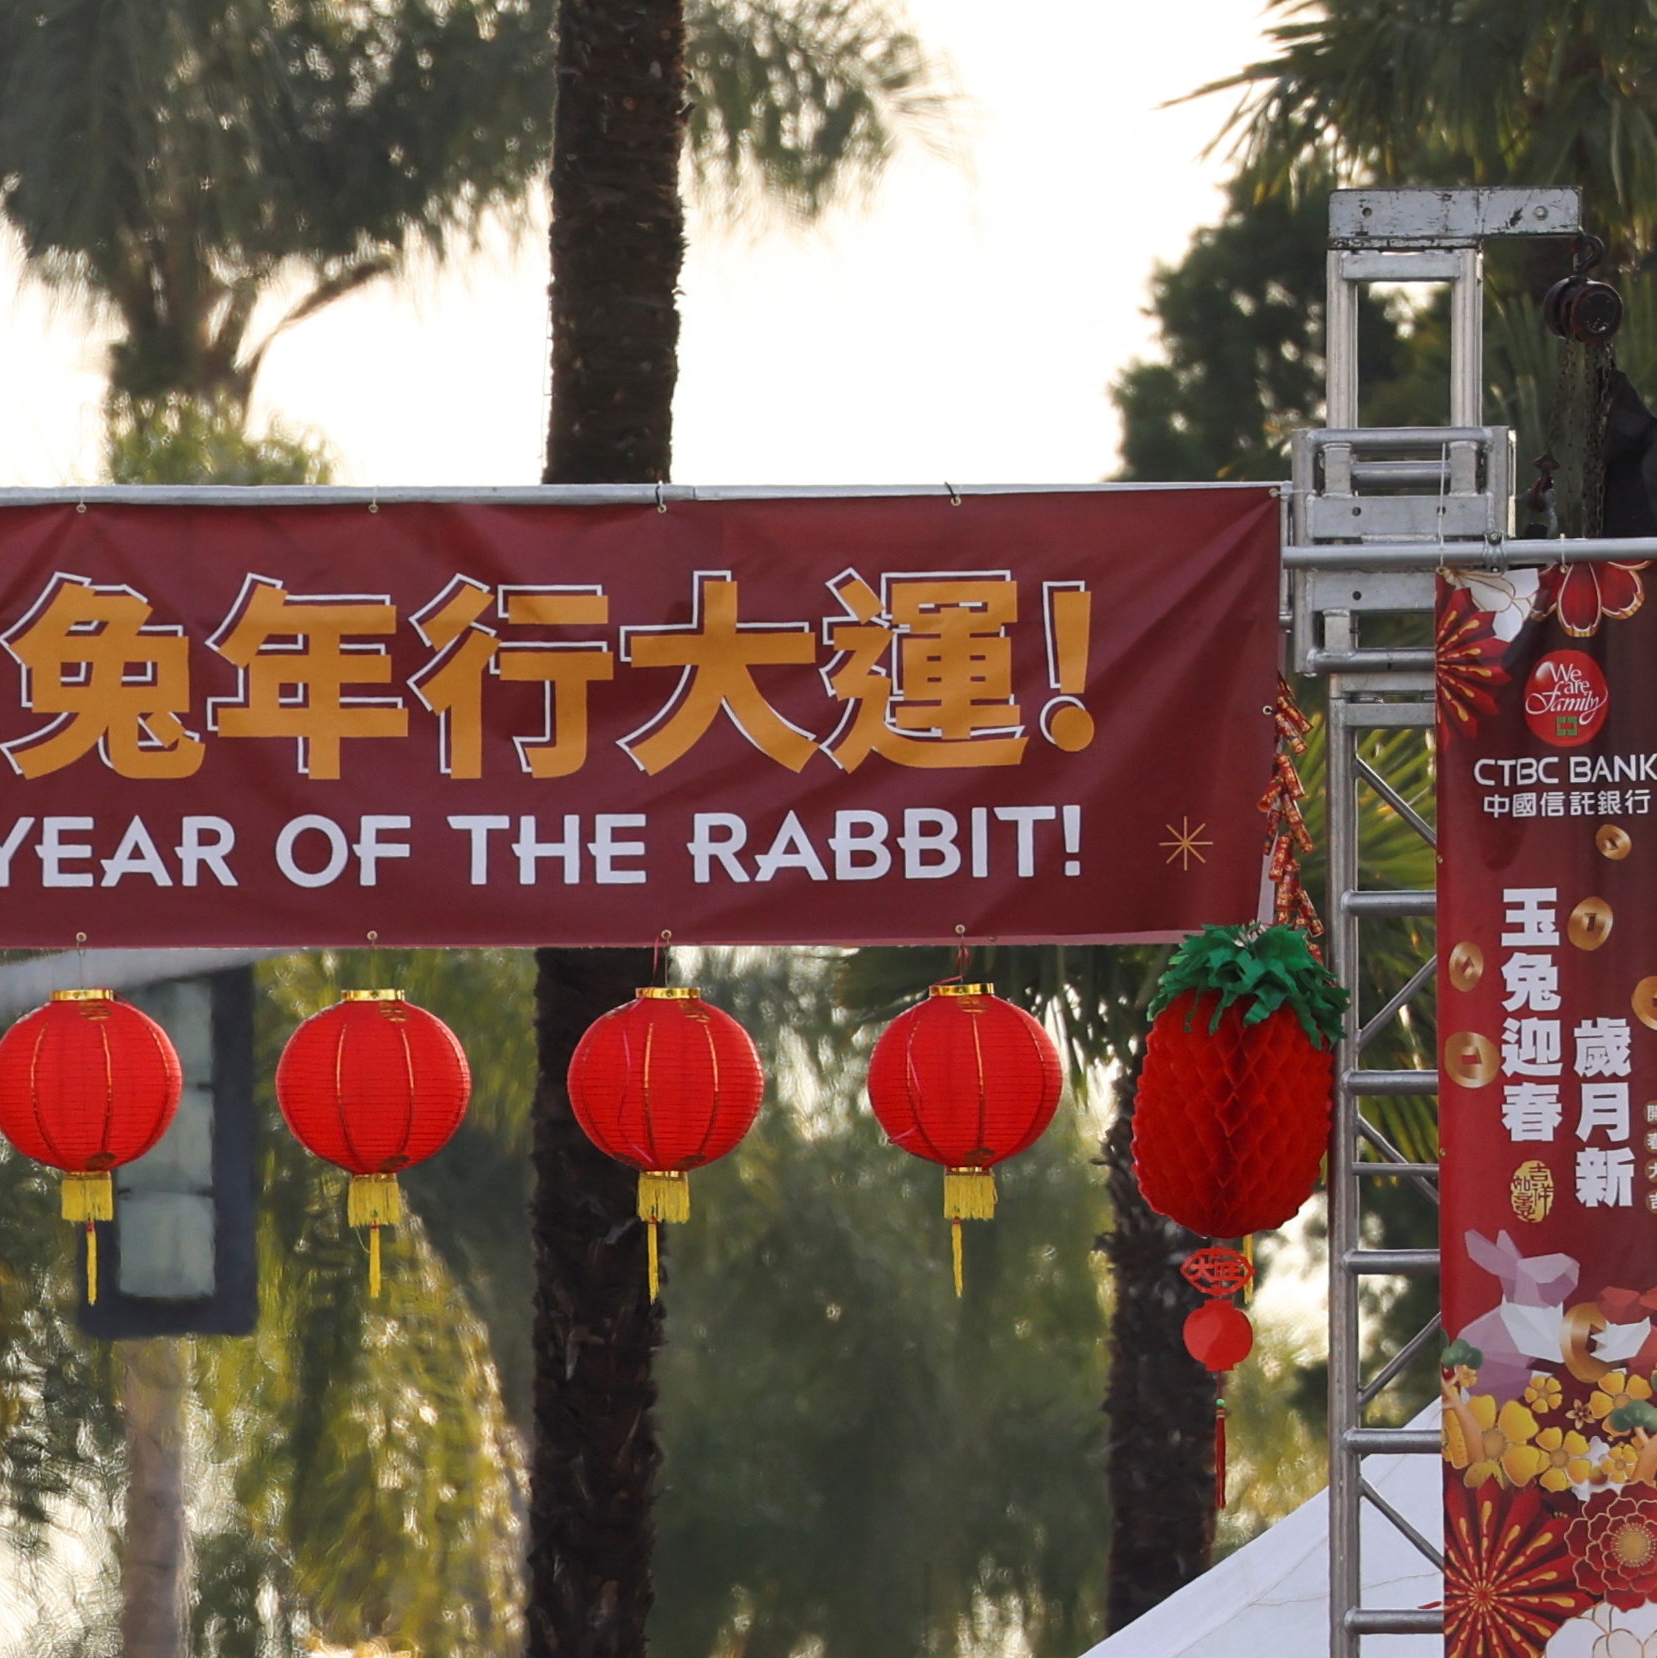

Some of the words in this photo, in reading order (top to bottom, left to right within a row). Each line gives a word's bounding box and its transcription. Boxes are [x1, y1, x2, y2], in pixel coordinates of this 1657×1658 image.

[1550, 663, 1582, 682] We
[1564, 679, 1590, 694] are
[1525, 681, 1609, 725] Family
[1473, 756, 1560, 787] CTBC
[1569, 753, 1657, 784] BANK
[1483, 789, 1652, 819] 中國信託銀行
[275, 814, 412, 888] OF
[448, 813, 648, 886] THE
[687, 805, 1083, 884] RABBIT!
[1500, 887, 1563, 1142] 玉兔迎春
[1573, 1016, 1636, 1208] 歲月新
